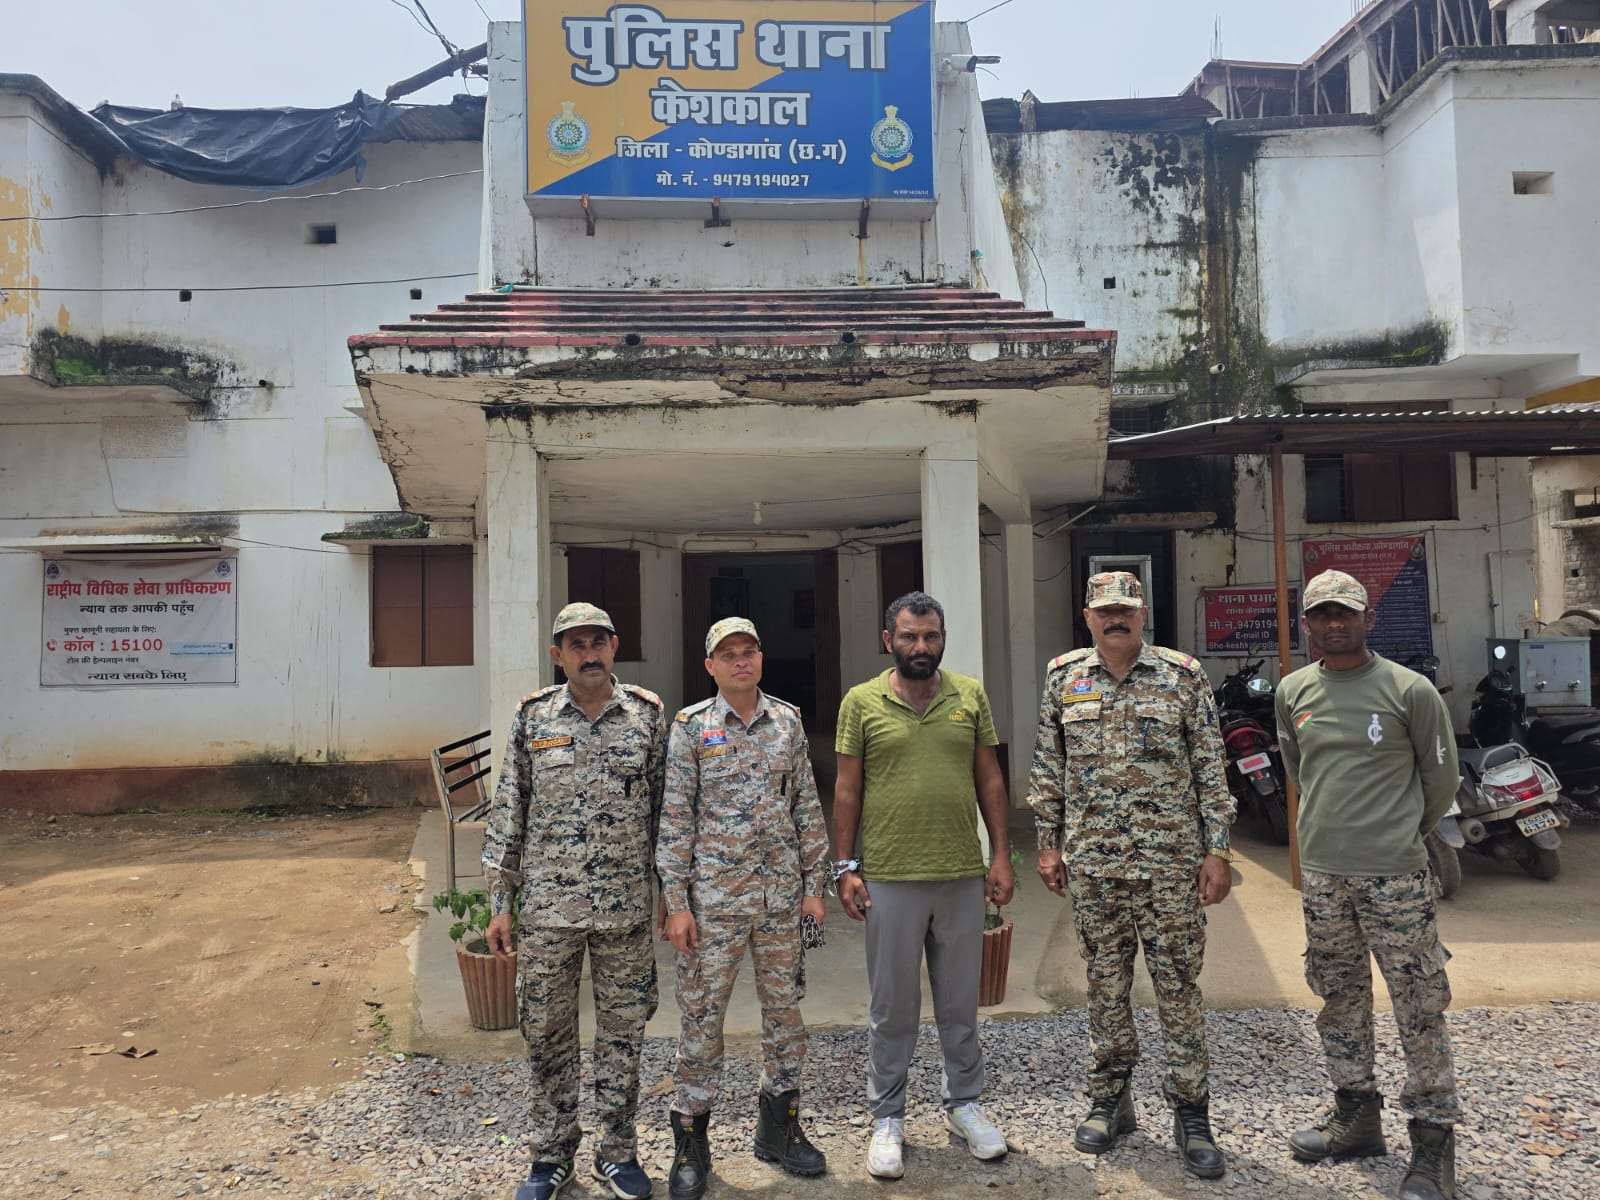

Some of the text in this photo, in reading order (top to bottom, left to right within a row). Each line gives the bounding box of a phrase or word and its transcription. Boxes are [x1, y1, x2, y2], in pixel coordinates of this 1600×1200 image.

[563, 5, 892, 84] पुलिस थाना
[650, 79, 811, 126] केशकाल
[615, 137, 670, 159] जिला
[688, 137, 782, 160] कोण्डागांव
[789, 138, 847, 164] (छ.ग)
[656, 170, 678, 187] मो.
[682, 170, 698, 187] नं.
[713, 173, 810, 187] 9479194027
[47, 578, 232, 600] राष्ट्रीय विधिक सेवा प्राधिकरण
[80, 604, 105, 614] न्याय
[110, 604, 128, 613] तक
[132, 601, 167, 613] आपकी
[1218, 594, 1245, 604] थाना
[64, 634, 95, 652] कॉल
[112, 638, 163, 652] 15100
[88, 672, 120, 681] न्याय
[161, 669, 187, 681] लिए
